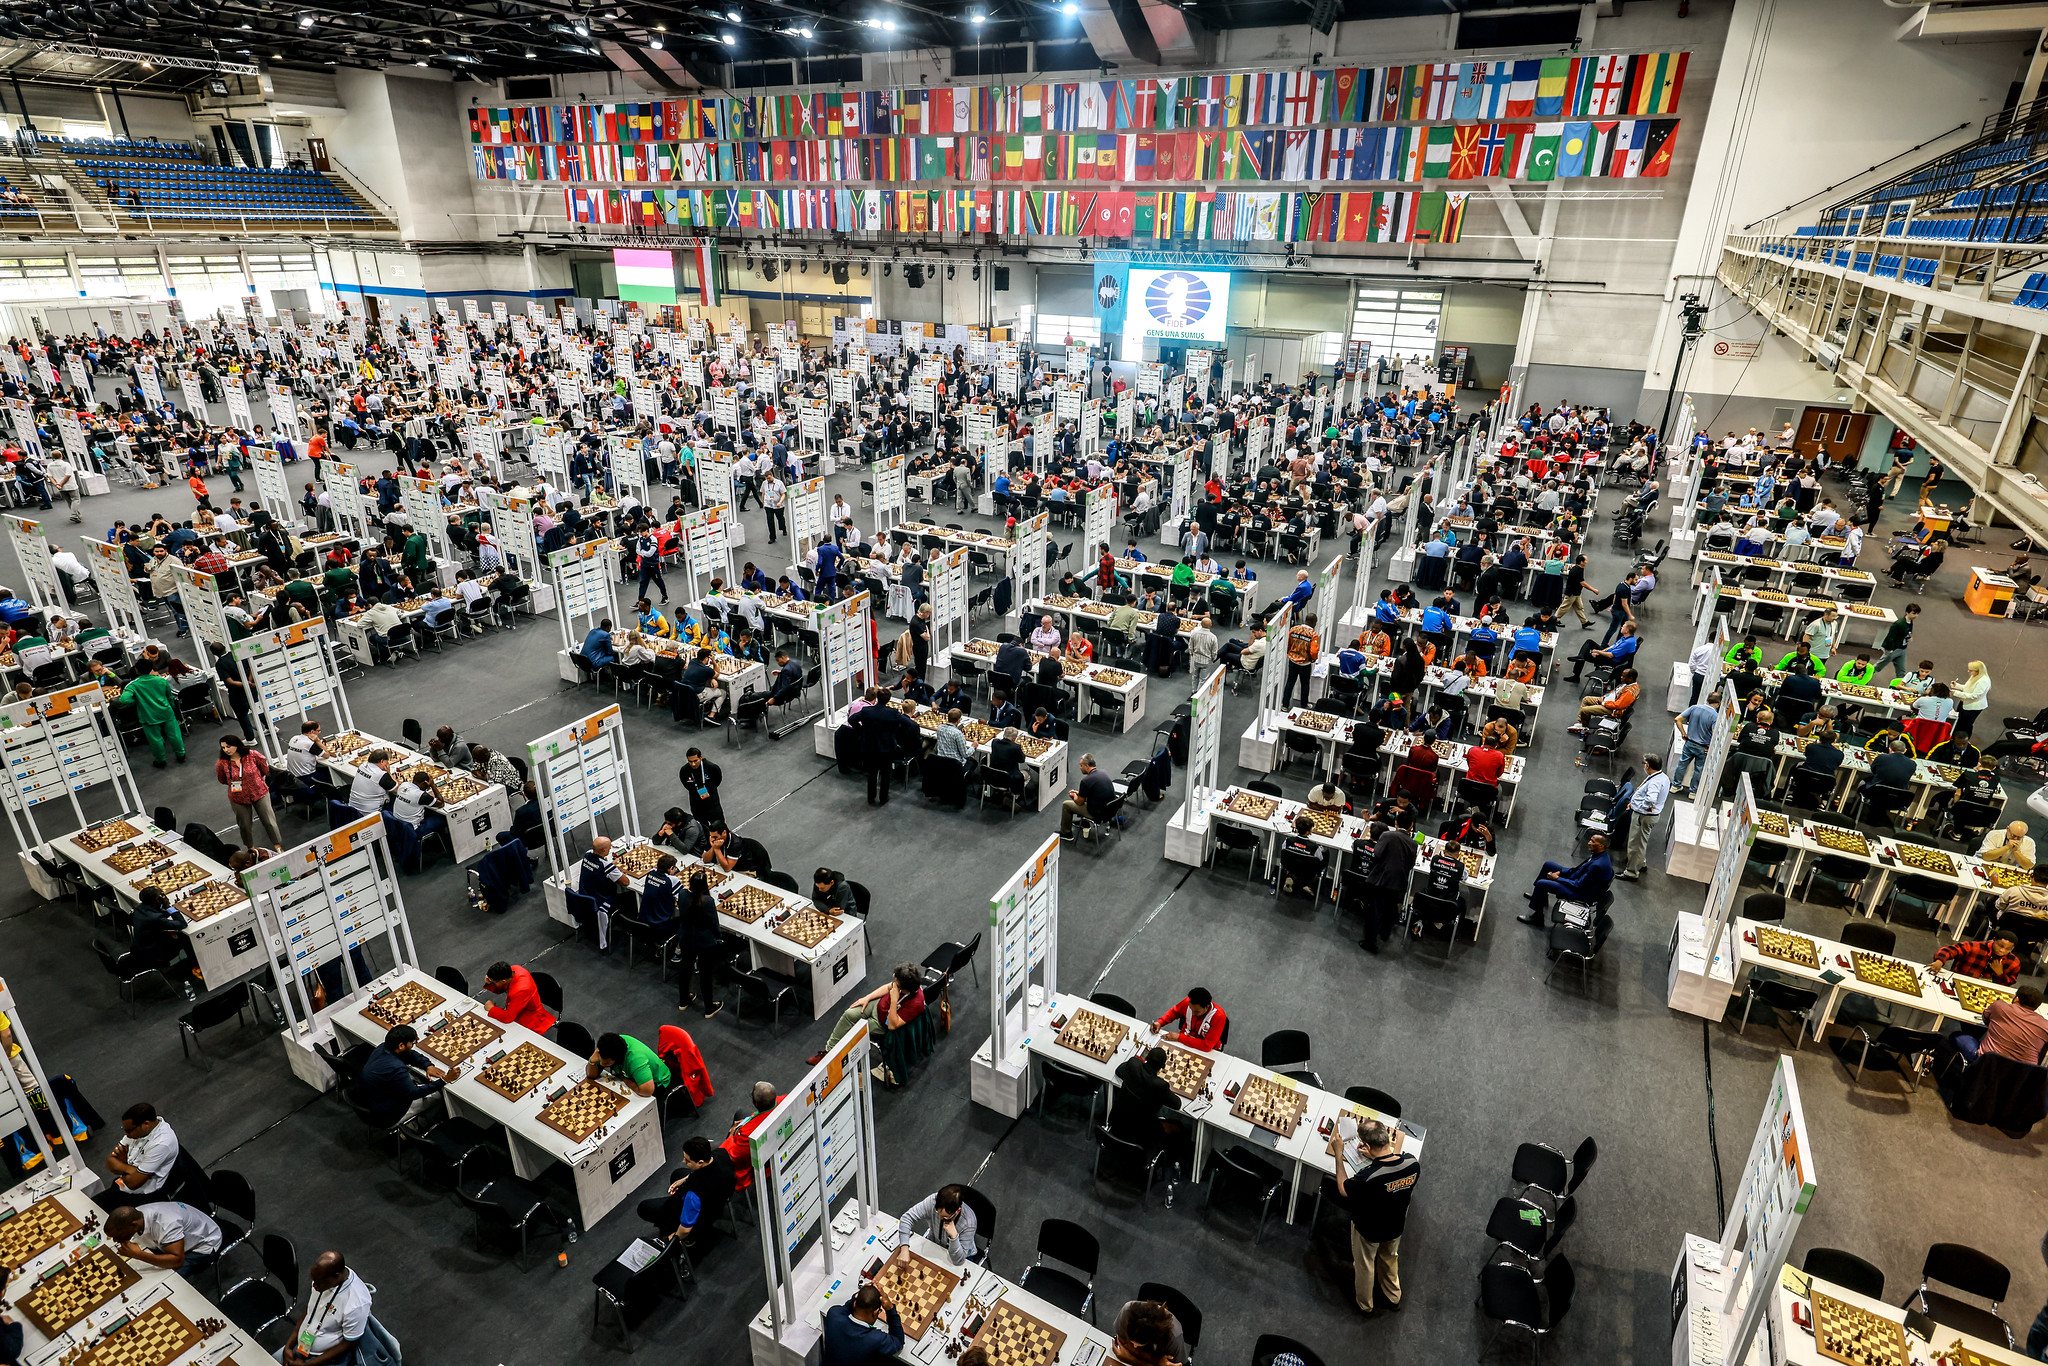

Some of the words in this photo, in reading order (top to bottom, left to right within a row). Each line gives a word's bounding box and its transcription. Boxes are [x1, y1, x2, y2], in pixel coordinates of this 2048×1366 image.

[1166, 320, 1184, 328] FIDE
[1425, 318, 1436, 333] 4
[1146, 329, 1163, 337] GENS
[1180, 331, 1204, 339] SUMUS
